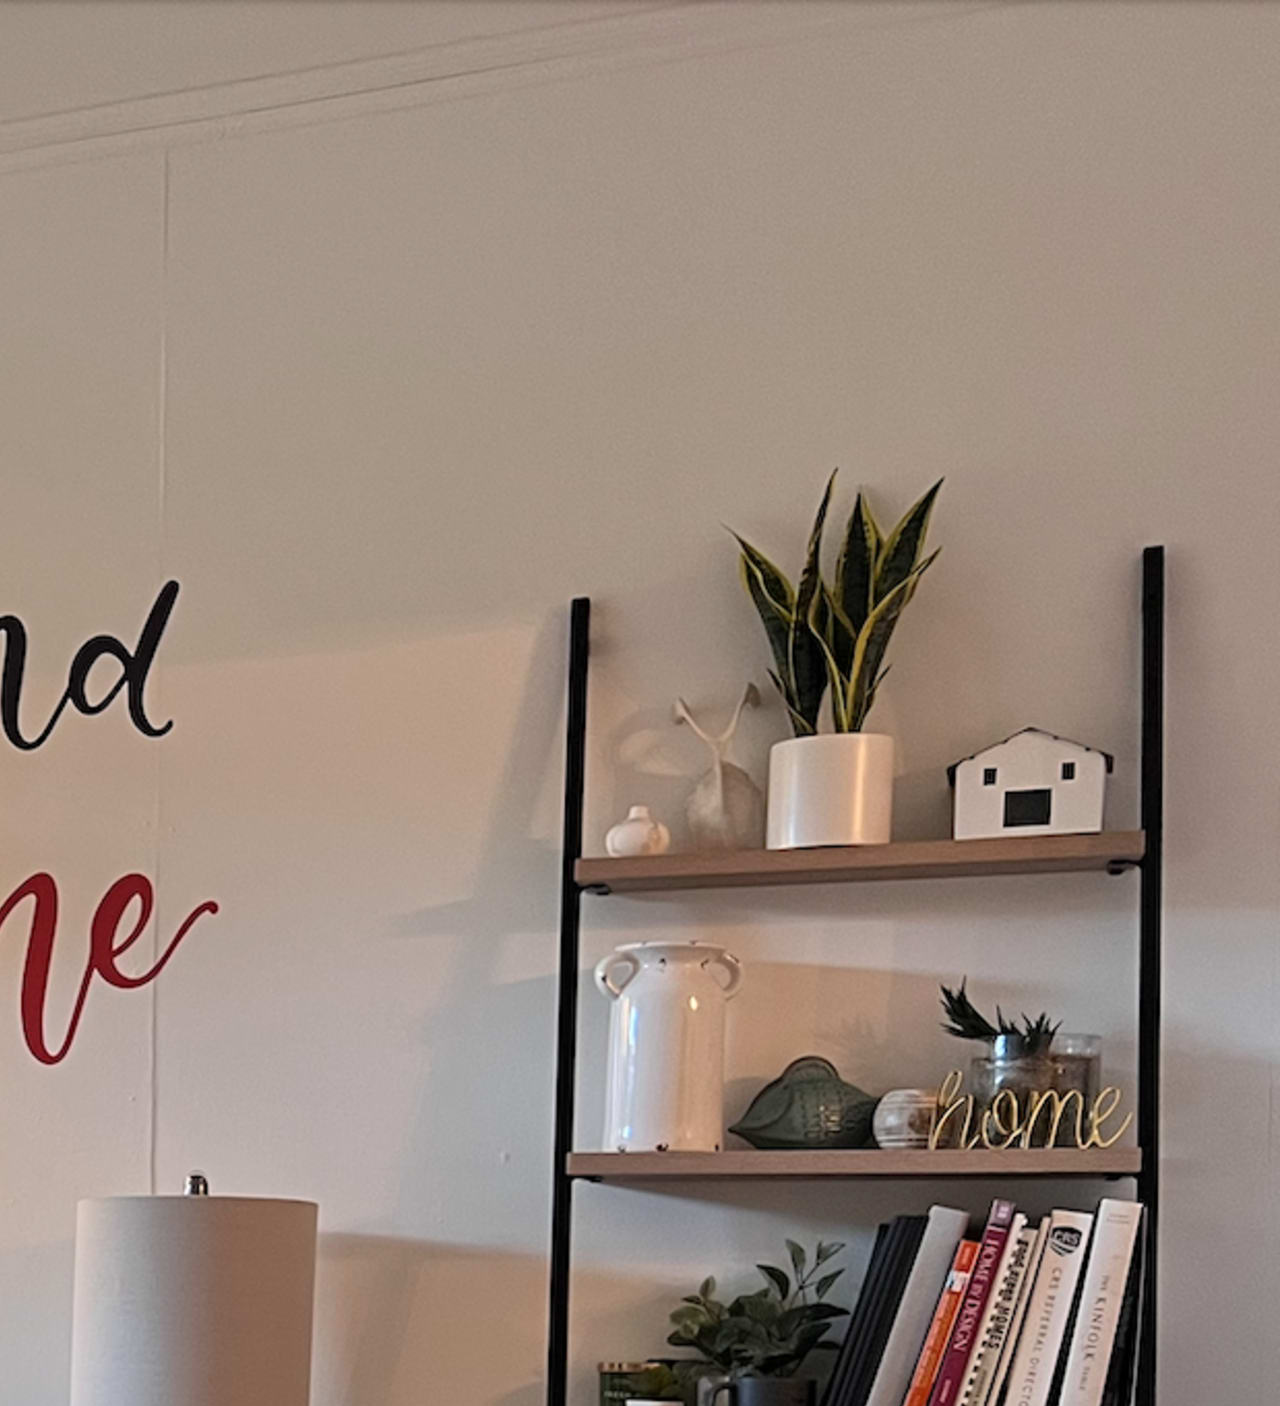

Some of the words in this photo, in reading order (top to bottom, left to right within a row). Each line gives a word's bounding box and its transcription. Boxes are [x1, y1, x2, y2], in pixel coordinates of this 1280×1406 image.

[928, 1070, 1134, 1151] home
[953, 1298, 977, 1352] DESIGN
[989, 1304, 1011, 1350] HOMES
[1032, 1294, 1056, 1357] REFERRAL
[1083, 1297, 1108, 1361] KINFOLK
